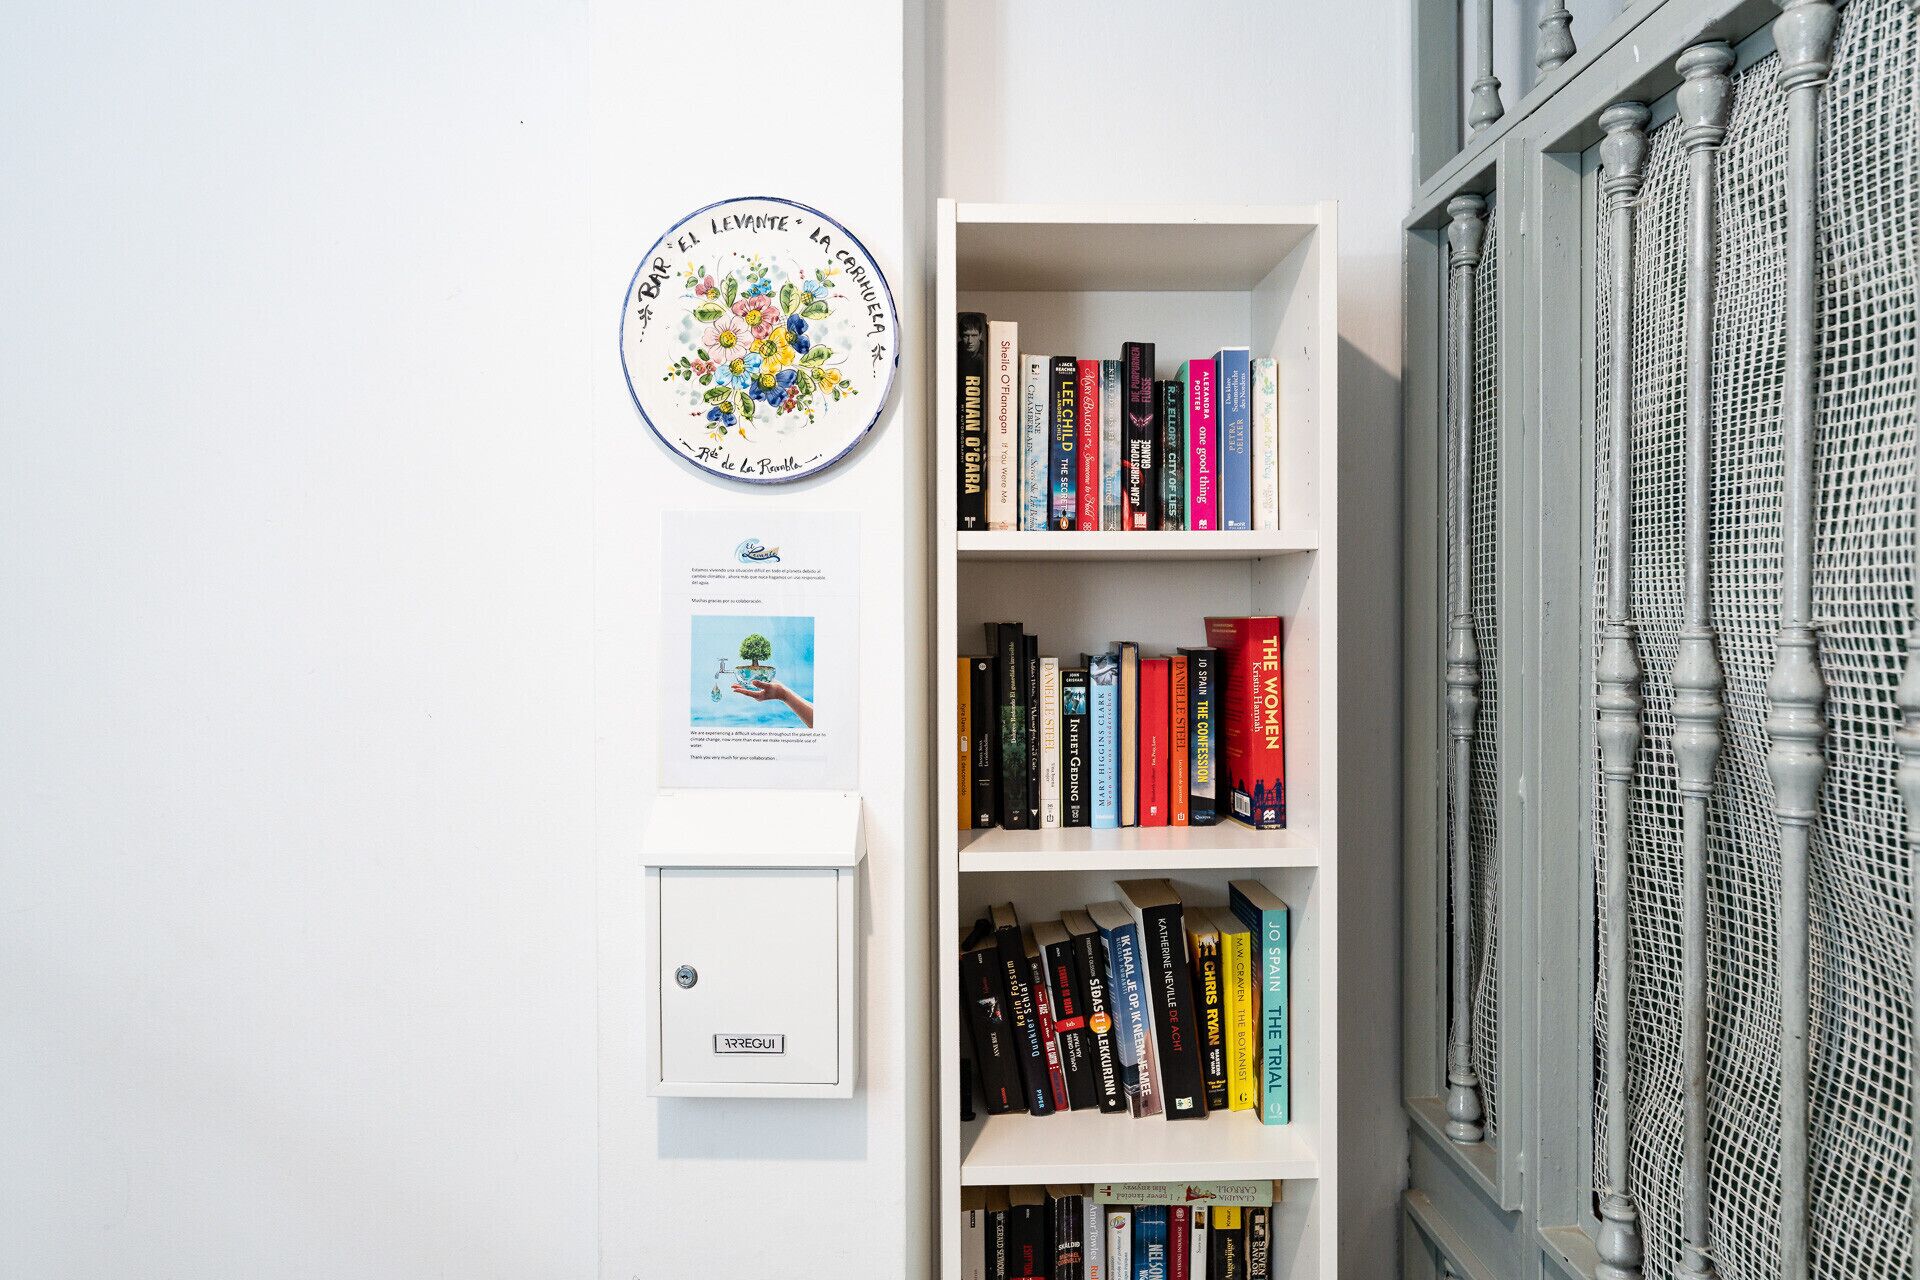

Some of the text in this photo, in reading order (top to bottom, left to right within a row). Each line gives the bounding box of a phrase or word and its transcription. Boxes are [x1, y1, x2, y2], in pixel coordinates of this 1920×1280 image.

[638, 227, 886, 337] BAR LA CARIHUELA
[1000, 340, 1011, 366] Sheila
[1062, 381, 1073, 408] LEE
[1081, 368, 1095, 396] MARY
[1131, 347, 1140, 403] DIE PURPURNEN
[1140, 377, 1151, 403] FLÜSSE
[1232, 369, 1240, 413] Sommerlicht
[998, 369, 1011, 434] O'Flanagan
[1027, 385, 1036, 453] CHAMBERLAIN
[1035, 404, 1043, 434] DIANE
[1083, 397, 1095, 437] BALOGH
[1169, 386, 1177, 448] R.J. ELLORY
[965, 375, 981, 494] RONAN O'GARA
[1062, 409, 1073, 452] CHILD
[1228, 421, 1236, 452] PETRA
[1236, 418, 1244, 454] OELKER
[721, 454, 803, 476] de La Rambla
[1001, 449, 1009, 464] You
[1061, 459, 1069, 474] THE
[1084, 453, 1094, 485] Someone
[1131, 439, 1140, 506] JEAN-CHRISTOPHE
[1196, 426, 1210, 504] one good thing
[1001, 490, 1008, 503] Me
[1169, 453, 1177, 516] CITY OF LIES
[1084, 494, 1095, 519] Hold
[1199, 658, 1207, 695] JO SPAIN
[1252, 661, 1264, 732] Kristin Hannah
[1262, 636, 1279, 749] THE WOMEN
[1009, 699, 1017, 723] Redondo
[1044, 662, 1056, 753] DANIELLE STEEL
[1176, 661, 1187, 752] DANIELLE STEEL
[1009, 723, 1017, 744] Dolores
[1197, 701, 1209, 783] THE CONFESSION
[1070, 719, 1081, 802] IN HET GEDING
[1088, 960, 1096, 977] OLSSON
[1236, 938, 1245, 1002] M.W. CRAVEN
[1268, 921, 1281, 992] JO SPAIN
[1005, 960, 1025, 1027] Karin Fossum
[1157, 917, 1182, 1051] KATHERINE NEVILLE DE ACHT
[1203, 961, 1220, 1046] CHRIS RYAN
[1018, 982, 1040, 1057] Dunkler Schlaf
[1121, 935, 1152, 1096] IK HAAL JE OP, IK NEEM JE MEE
[724, 1038, 775, 1049] ARREGUI
[1089, 978, 1116, 1096] SÍÐASTI HLEKKURINN
[1210, 1052, 1216, 1061] OF
[1237, 1009, 1246, 1081] THE BOTANIST
[1268, 1005, 1282, 1094] THE TRIAL
[1069, 1051, 1078, 1072] CAMILLA
[1036, 1089, 1045, 1108] PIPER
[1117, 1192, 1146, 1202] fancied
[1123, 1184, 1167, 1193] him anyway
[1217, 1185, 1258, 1195] CARROLL
[1218, 1194, 1256, 1202] CLAUDIA
[1090, 1203, 1099, 1260] Amor Towles
[1251, 1241, 1259, 1276] SAYLOR
[1258, 1240, 1266, 1276] STEVEN
